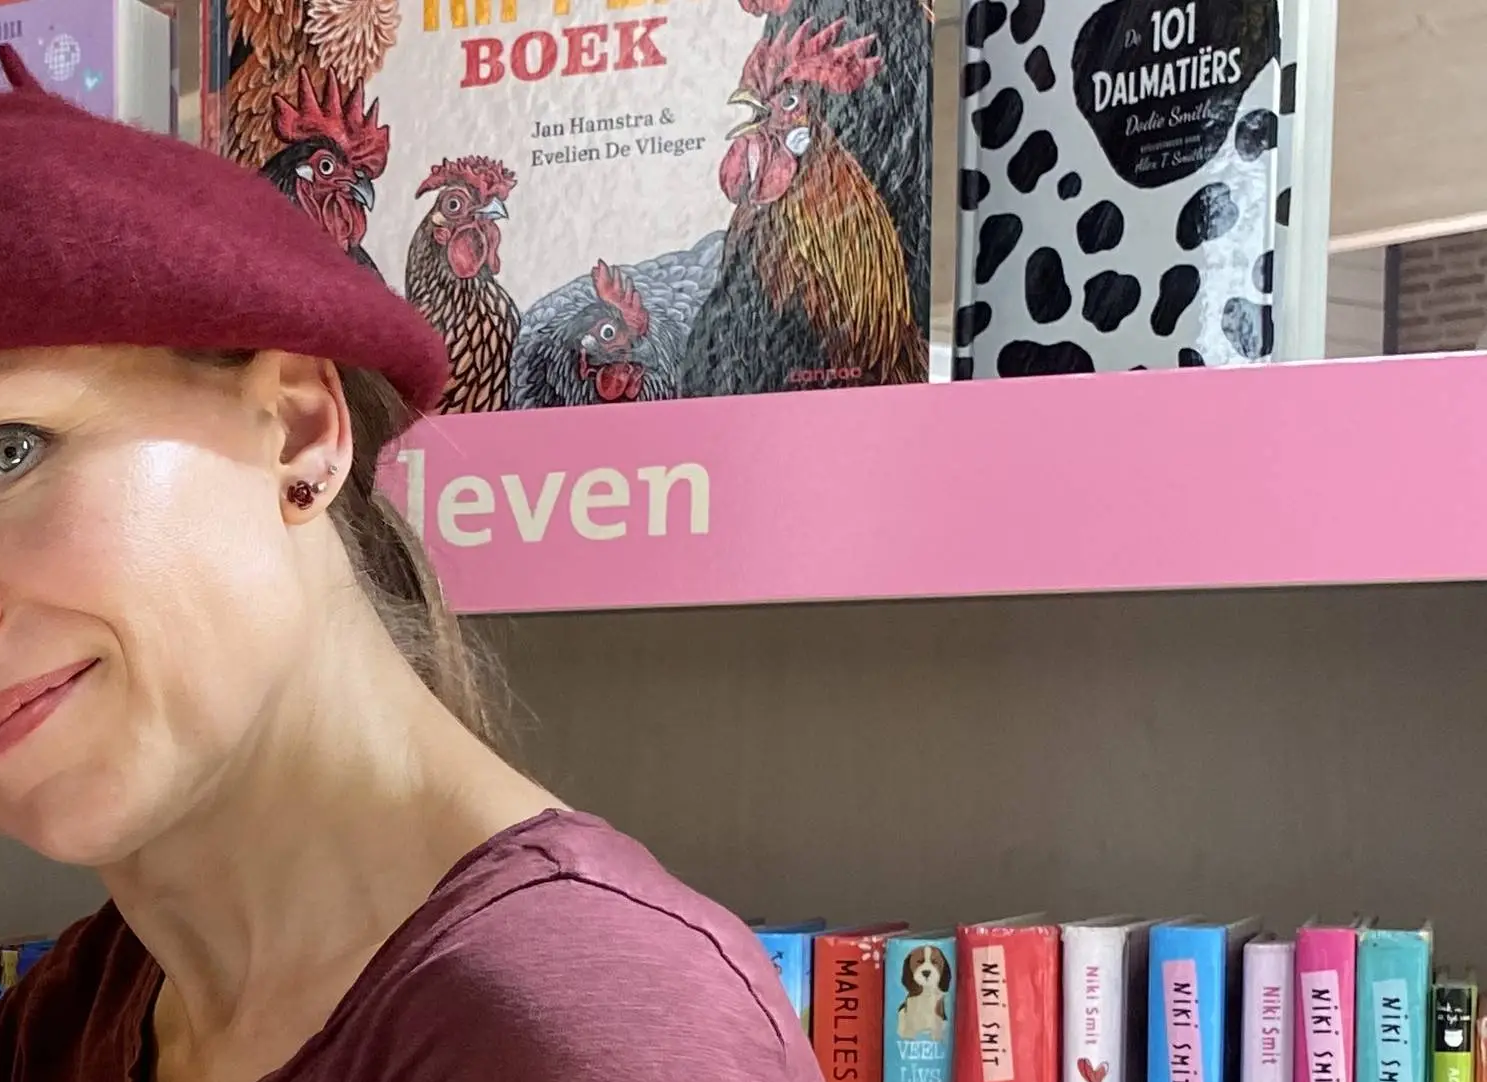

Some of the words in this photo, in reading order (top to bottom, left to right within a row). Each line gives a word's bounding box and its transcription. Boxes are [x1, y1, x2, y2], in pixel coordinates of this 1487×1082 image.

[1151, 1, 1196, 53] 101
[460, 16, 668, 88] BOEK
[1091, 46, 1242, 113] DALMATIËRS
[531, 121, 565, 139] Jan
[569, 112, 654, 136] Hamstra
[659, 107, 675, 125] &
[1125, 110, 1164, 136] Dodie
[531, 147, 601, 167] Evelien
[605, 142, 631, 160] De
[636, 135, 706, 158] Vlieger
[981, 962, 1007, 1007] NIKI
[1085, 965, 1099, 1000] Niki
[1262, 986, 1281, 1021] Niki
[833, 959, 860, 1081] MARLIES
[1085, 1006, 1101, 1046] Smit
[1172, 982, 1198, 1029] NIKI
[1311, 988, 1339, 1036] NIKI
[1380, 996, 1409, 1046] NIKI
[897, 1041, 946, 1060] VEEL
[981, 1022, 1006, 1067] SMIT
[1262, 1027, 1281, 1065] Smit
